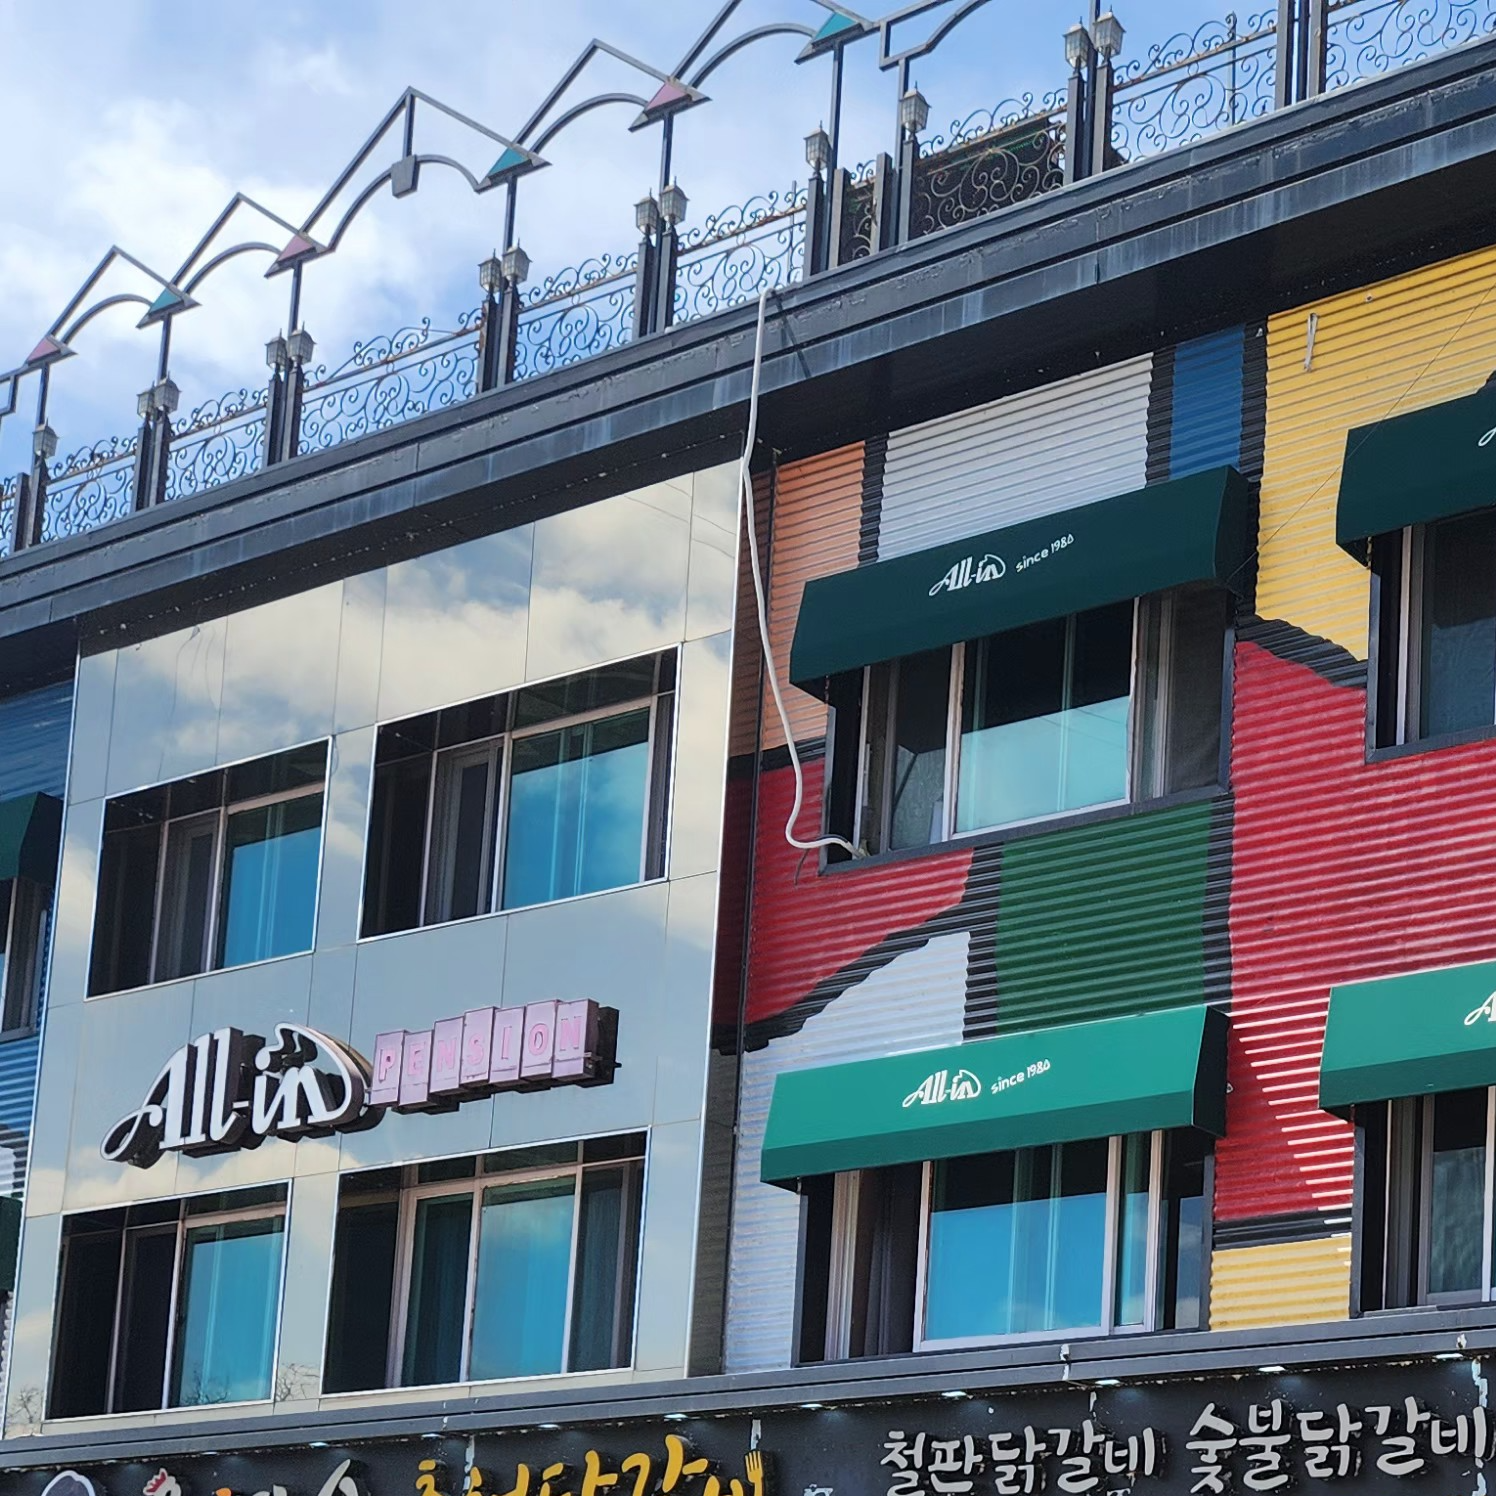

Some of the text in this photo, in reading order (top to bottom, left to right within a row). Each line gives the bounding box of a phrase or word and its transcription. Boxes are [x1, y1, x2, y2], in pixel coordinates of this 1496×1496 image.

[1015, 548, 1049, 573] since
[379, 1017, 582, 1081] PENSION
[991, 1072, 1025, 1095] since
